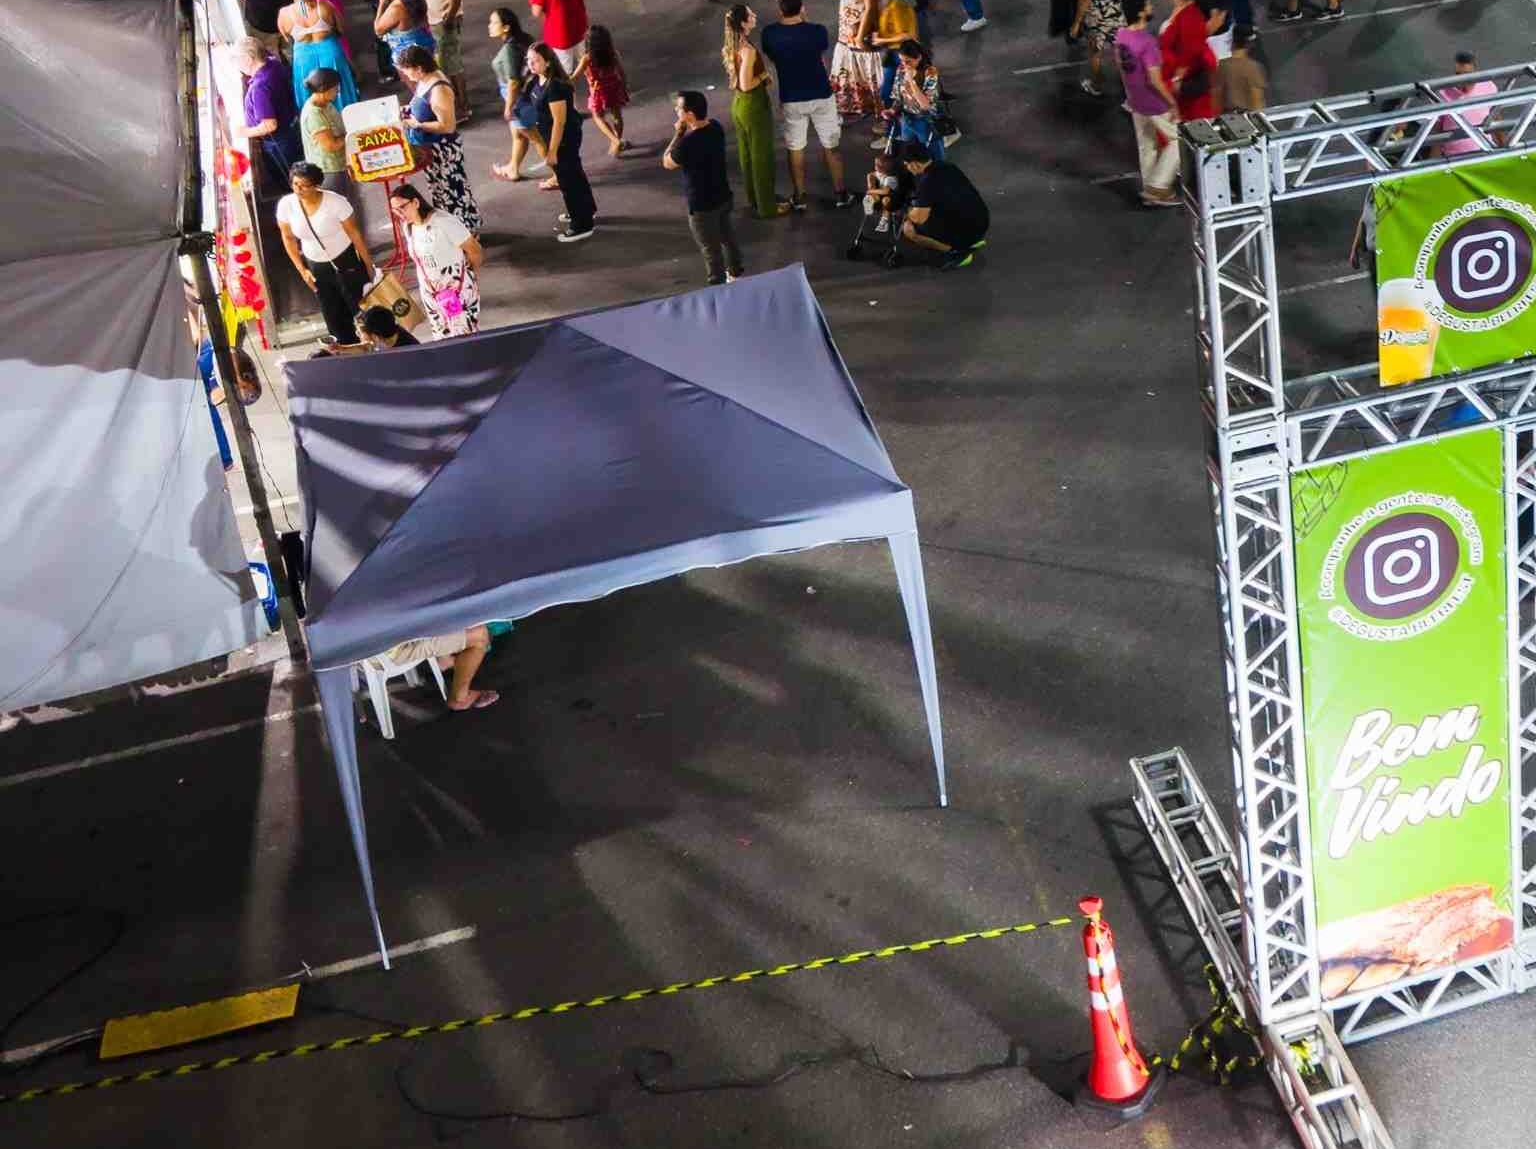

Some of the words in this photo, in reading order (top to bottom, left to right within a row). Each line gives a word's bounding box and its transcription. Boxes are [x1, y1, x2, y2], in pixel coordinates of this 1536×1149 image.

[357, 130, 400, 149] CAIXA
[1330, 704, 1481, 790] Bem
[1328, 743, 1502, 860] Vindo
